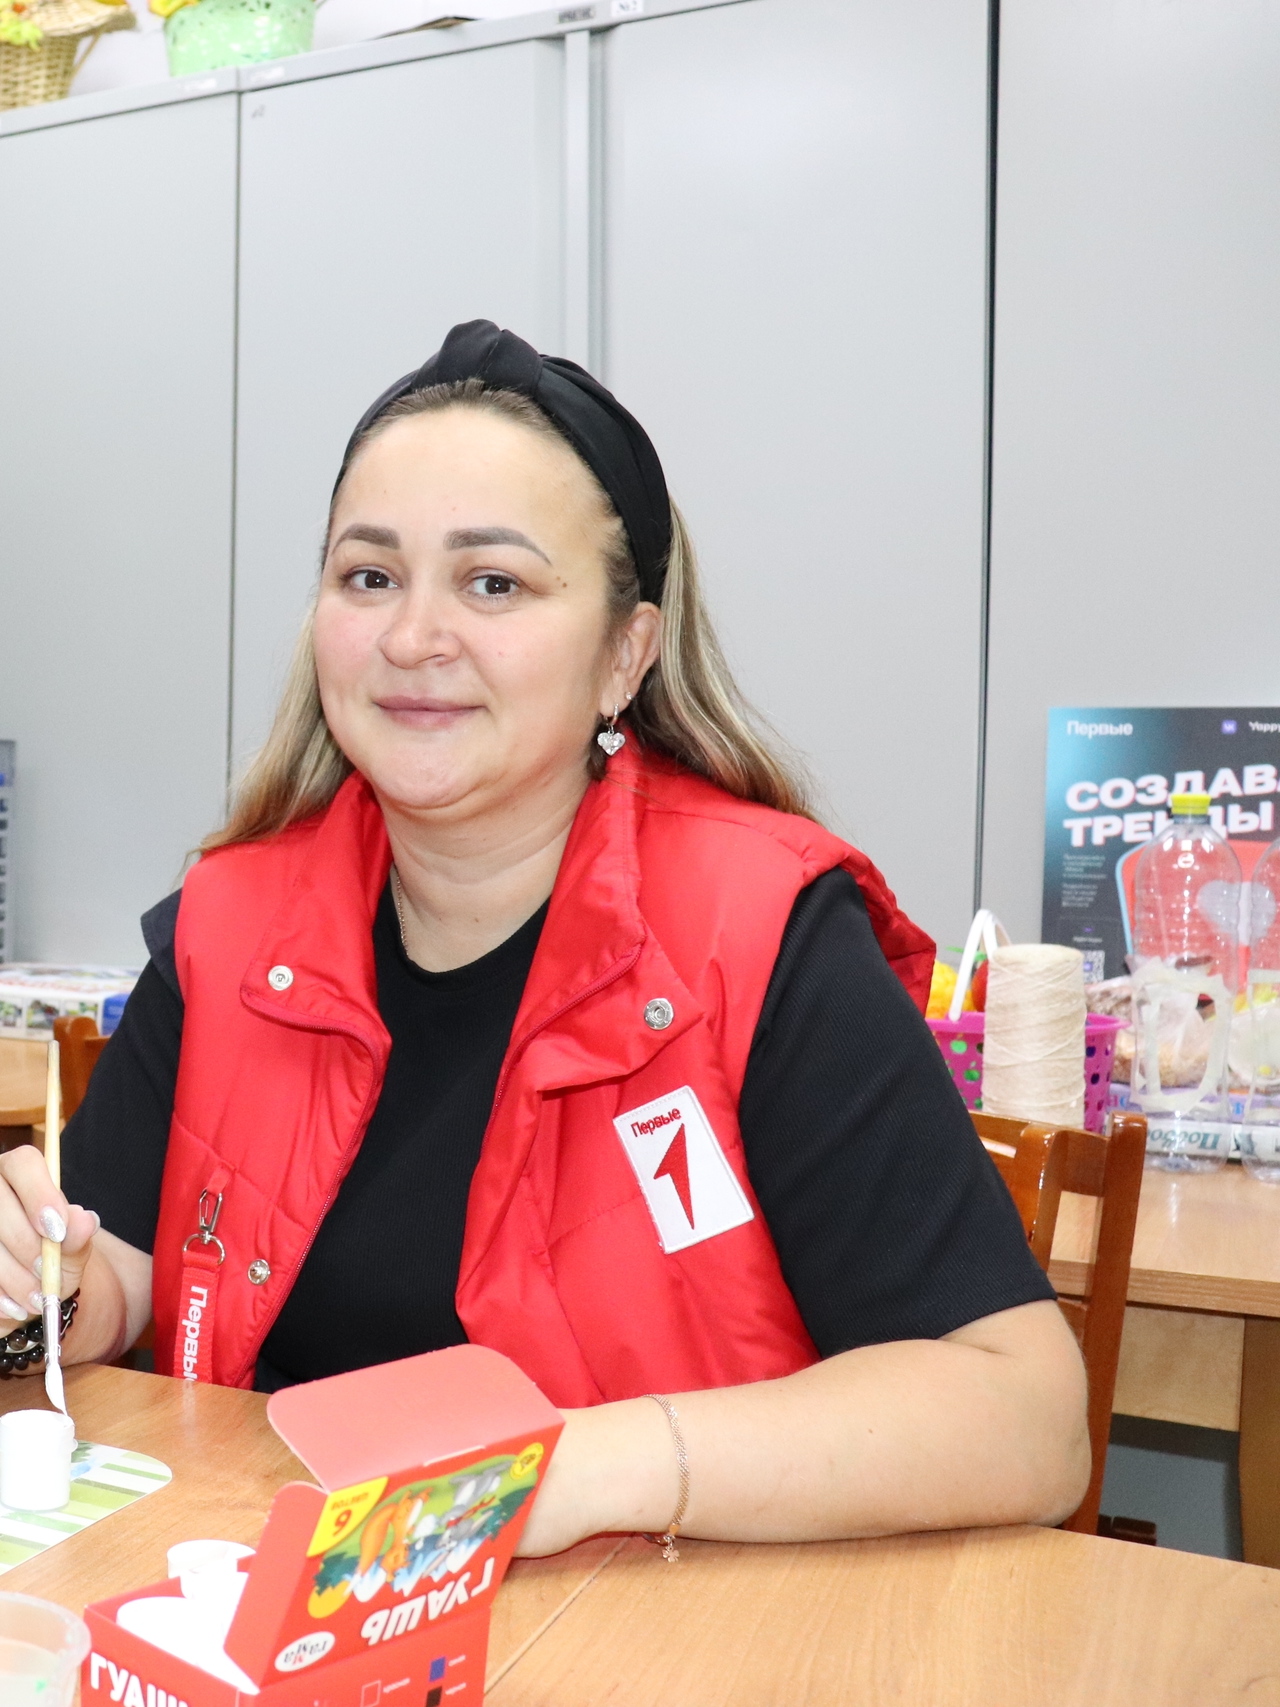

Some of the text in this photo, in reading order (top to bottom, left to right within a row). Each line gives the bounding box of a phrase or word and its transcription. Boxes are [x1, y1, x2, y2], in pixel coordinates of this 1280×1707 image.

[1066, 720, 1134, 740] Первые
[1065, 763, 1280, 812] СОЗДАВ
[631, 1107, 682, 1138] Первые
[181, 1285, 208, 1382] Первы
[333, 1509, 352, 1537] 6
[360, 1556, 495, 1646] ГУАШЬ
[90, 1651, 189, 1707] ГУА
